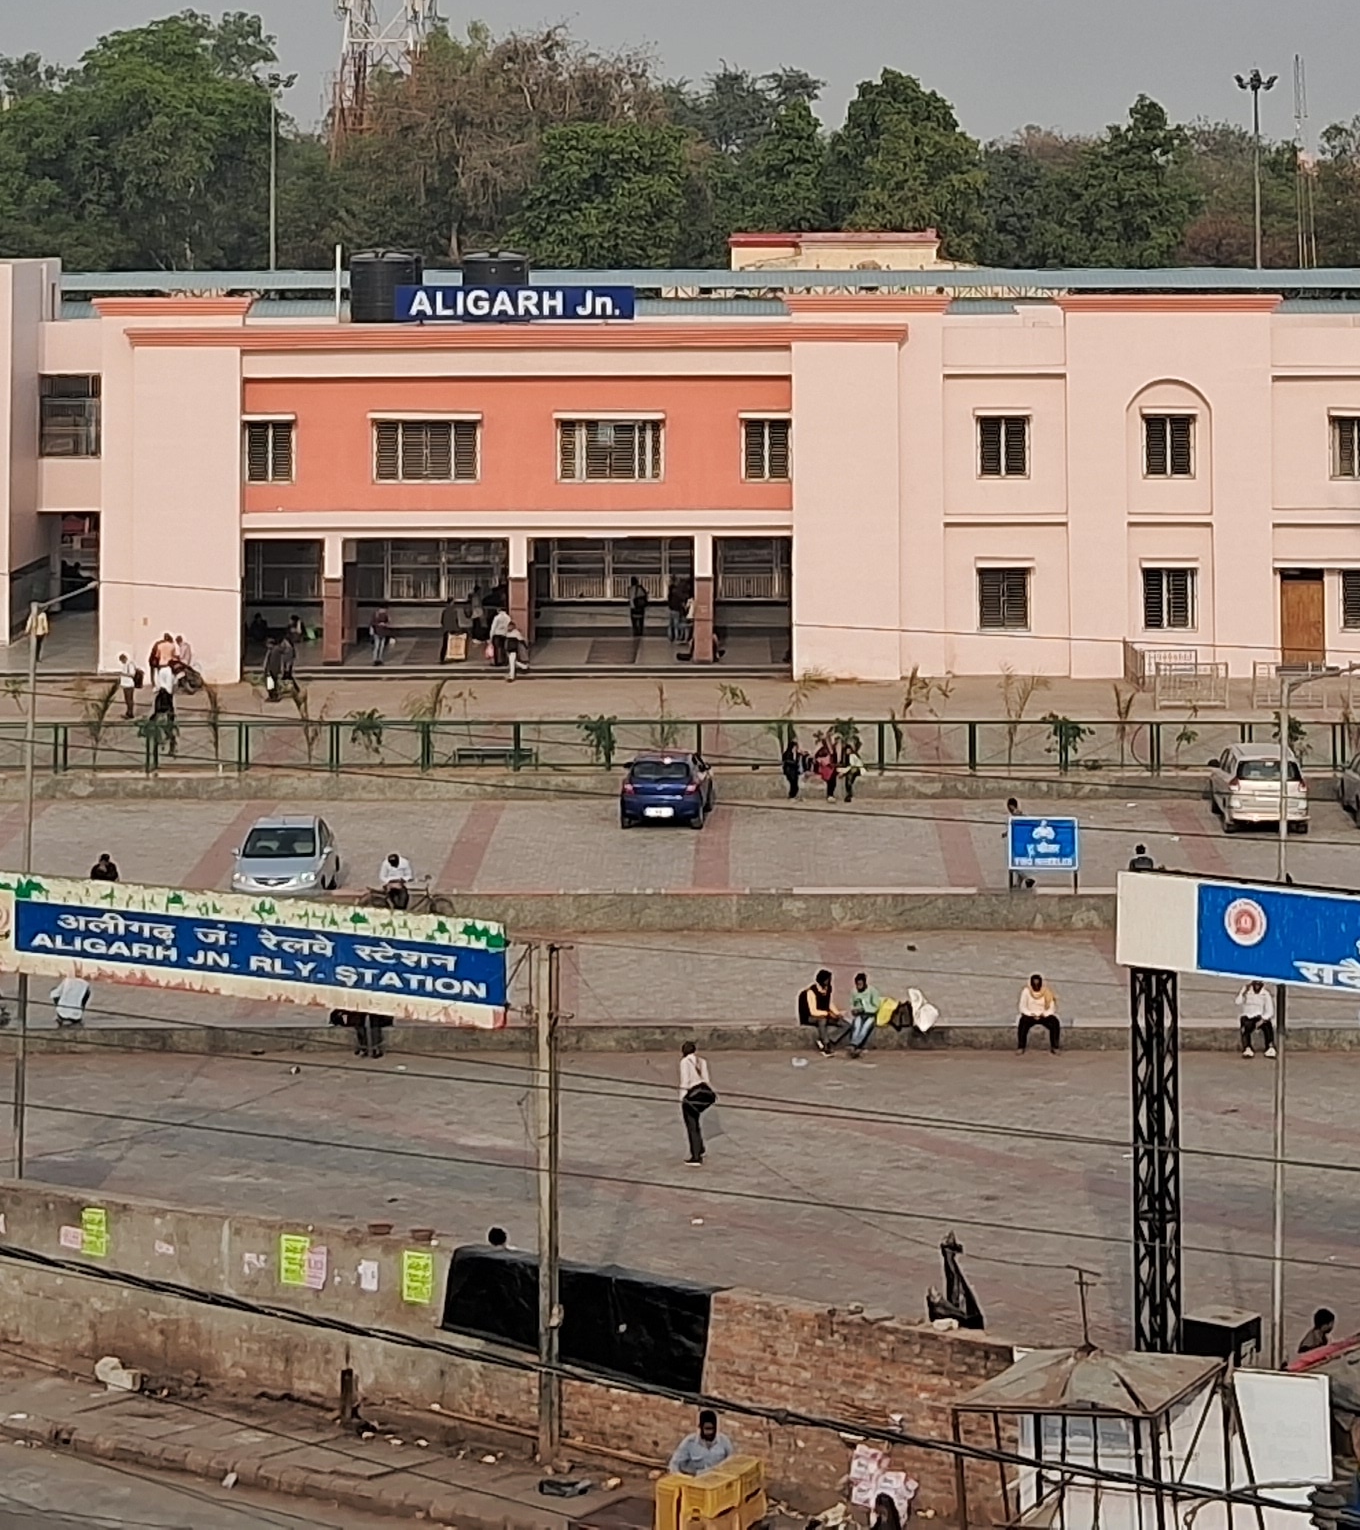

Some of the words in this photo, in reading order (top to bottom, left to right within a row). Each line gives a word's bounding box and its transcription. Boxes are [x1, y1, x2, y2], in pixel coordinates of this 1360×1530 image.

[408, 289, 564, 317] ALIGARH
[575, 289, 621, 317] Jn.
[30, 932, 179, 963] ALIGARH
[186, 949, 239, 970] JN.
[248, 955, 324, 983] RLY.
[335, 965, 488, 999] STATION
[56, 912, 176, 945] अलीगढ़
[257, 927, 335, 959] रेलवे
[353, 940, 458, 974] स्टेशन
